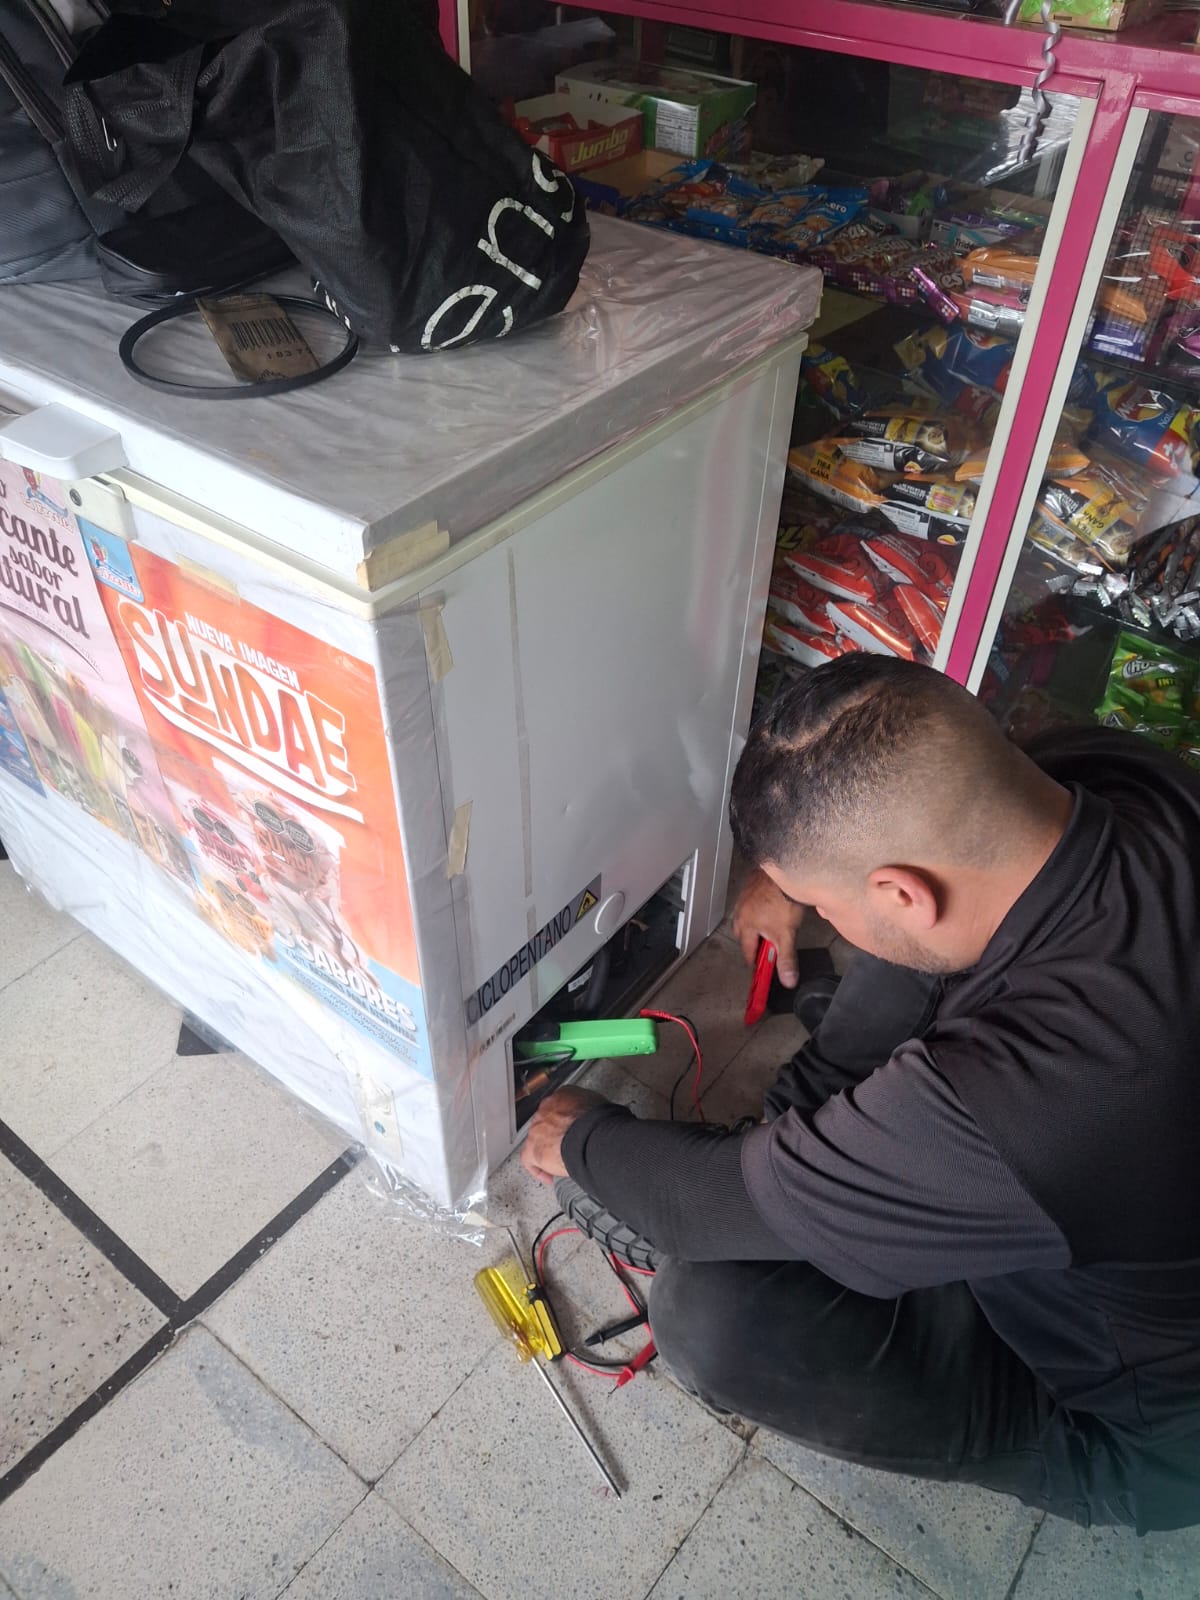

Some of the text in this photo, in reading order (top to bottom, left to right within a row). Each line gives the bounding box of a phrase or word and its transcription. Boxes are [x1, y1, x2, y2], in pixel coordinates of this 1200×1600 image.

[570, 127, 629, 165] Jumbo
[9, 545, 63, 591] sabor
[184, 611, 301, 691] NUEVA IMAGEN
[117, 597, 357, 797] SUNDAE
[295, 933, 418, 1033] SABORES
[466, 904, 572, 1025] CICLOPENTANO
